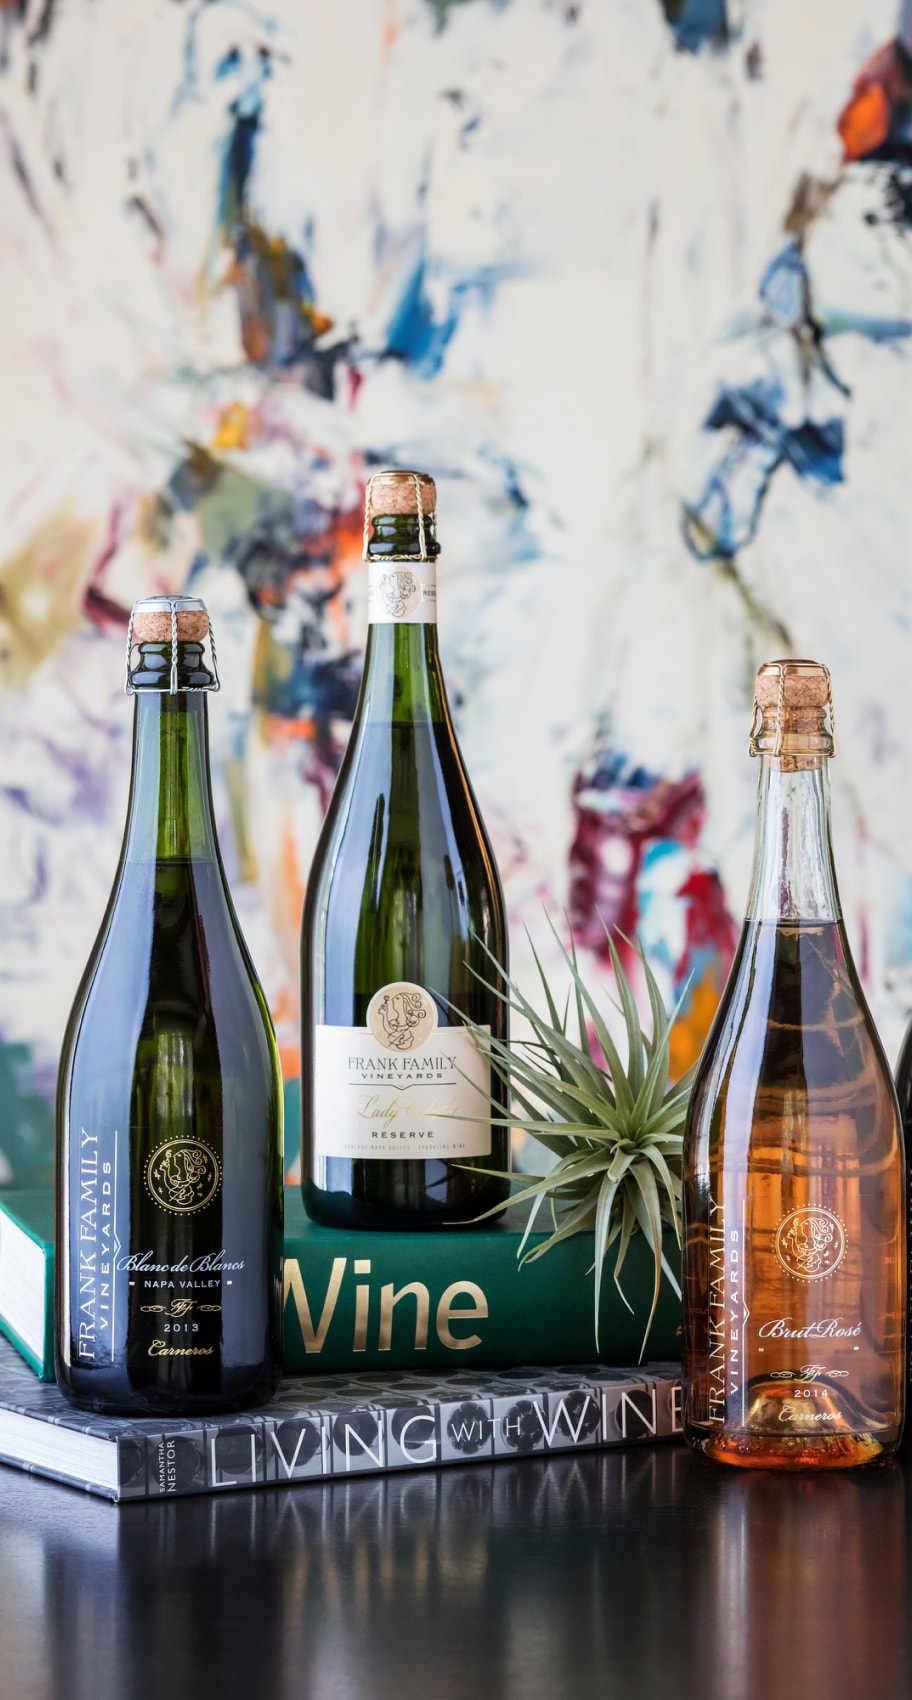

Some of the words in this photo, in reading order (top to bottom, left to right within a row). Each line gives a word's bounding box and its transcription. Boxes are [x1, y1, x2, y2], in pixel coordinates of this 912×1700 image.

[348, 1056, 399, 1071] FRANK
[403, 1056, 457, 1071] FAMILY
[355, 1094, 402, 1128] Lady
[371, 1131, 434, 1139] RESERVE
[79, 1127, 98, 1243] FAMILY
[100, 1161, 112, 1330] VINEYARDS
[116, 1250, 171, 1273] Blanc
[171, 1255, 189, 1273] de
[189, 1249, 246, 1273] Blancs
[708, 1197, 726, 1309] FAMILY
[144, 1280, 175, 1289] NAPA
[179, 1279, 221, 1289] VALLEY
[78, 1245, 97, 1360] FRANK
[283, 1257, 489, 1354] Wine
[730, 1229, 739, 1395] VINEYARDS
[163, 1323, 200, 1333] 2013
[758, 1316, 813, 1339] Brut
[809, 1316, 862, 1339] Rosé
[147, 1339, 214, 1357] Carneros
[709, 1315, 725, 1424] FRANK
[793, 1388, 829, 1398] 2014
[777, 1404, 843, 1422] Carneros
[167, 1440, 176, 1492] NESTOR
[210, 1415, 437, 1487] LIVING
[451, 1416, 521, 1443] WITH
